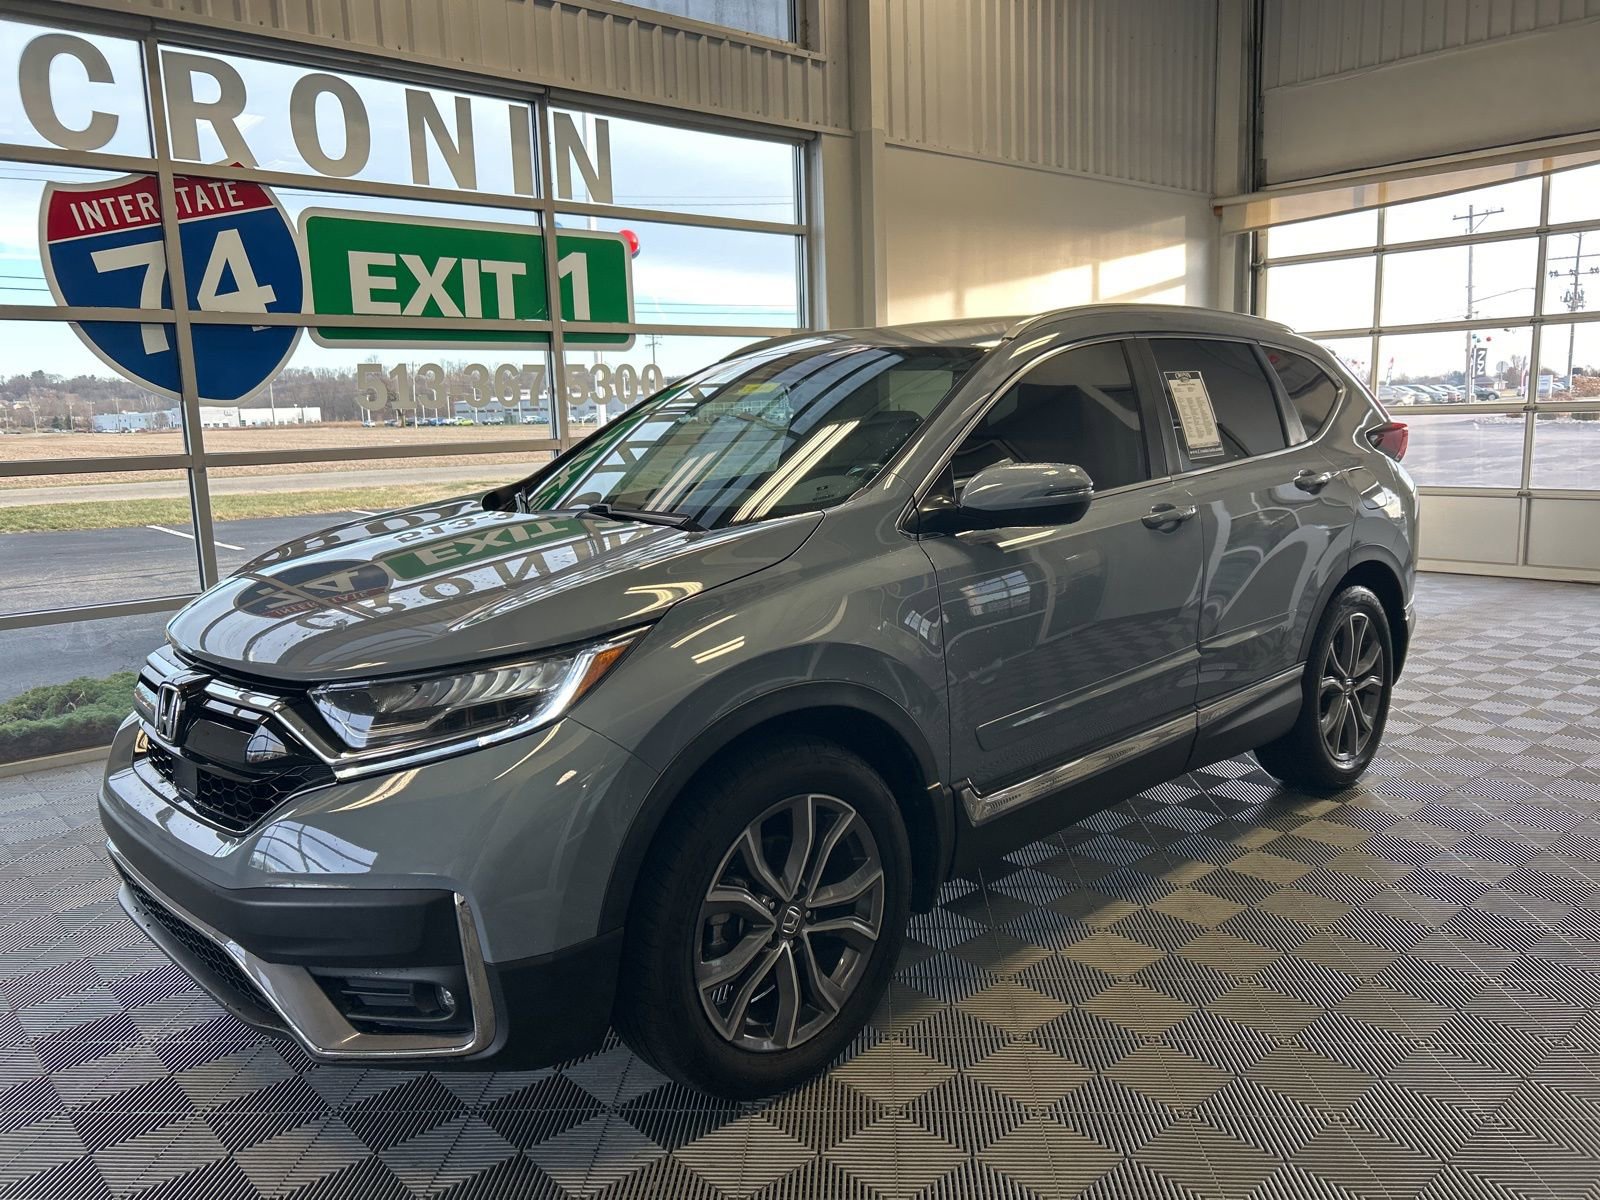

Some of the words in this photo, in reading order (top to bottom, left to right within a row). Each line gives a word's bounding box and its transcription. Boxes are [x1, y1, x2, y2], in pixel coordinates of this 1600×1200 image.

[18, 33, 614, 204] CRONIN
[70, 181, 245, 231] INTERTATE
[90, 228, 278, 355] 74
[347, 250, 527, 320] EXIT
[557, 251, 591, 321] 1
